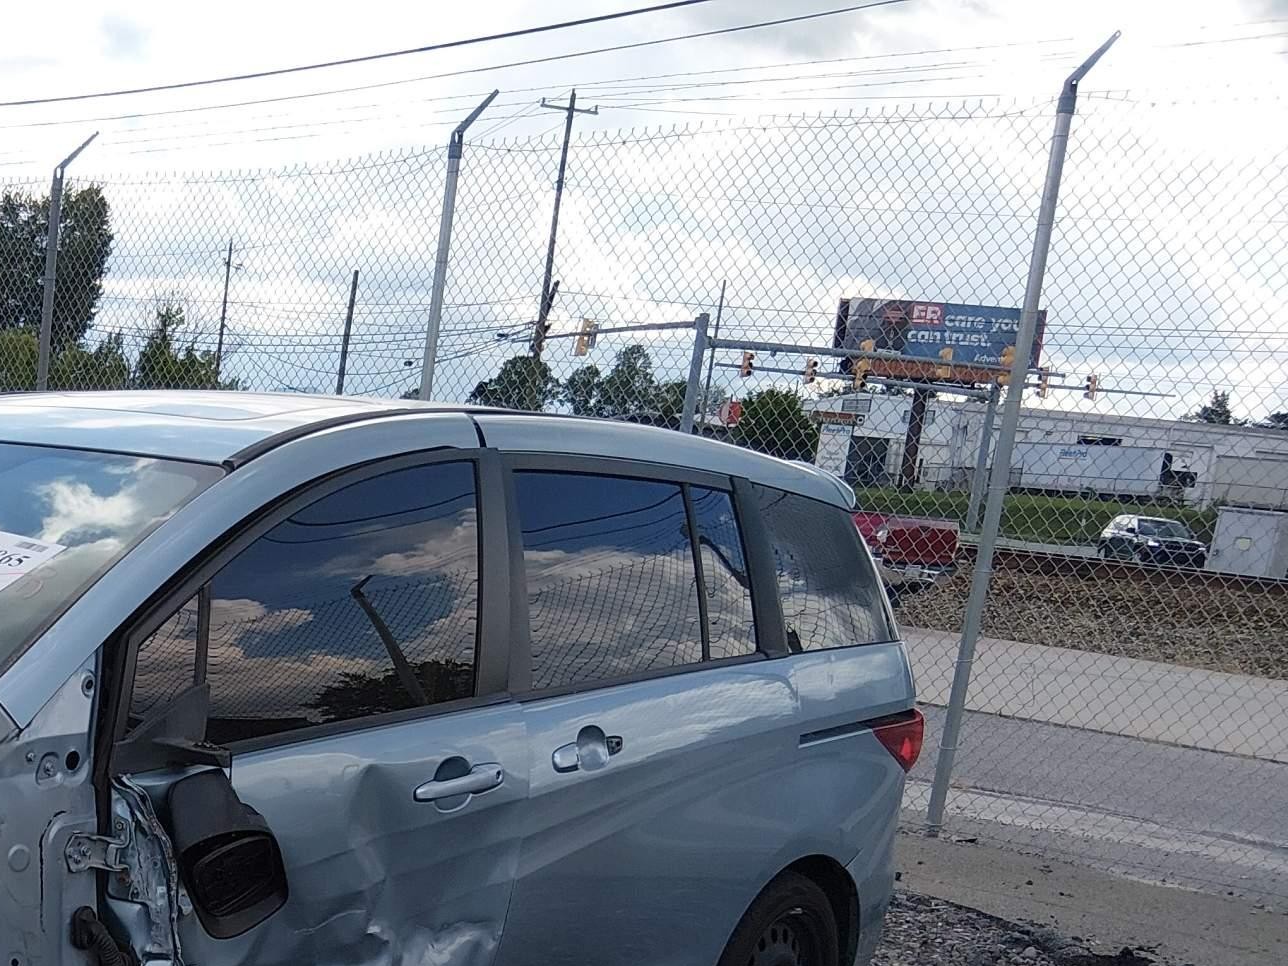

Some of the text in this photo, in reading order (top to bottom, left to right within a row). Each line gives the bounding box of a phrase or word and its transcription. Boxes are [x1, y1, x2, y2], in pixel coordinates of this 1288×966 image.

[912, 304, 942, 324] ER
[944, 314, 986, 329] care
[907, 330, 993, 347] can trust.
